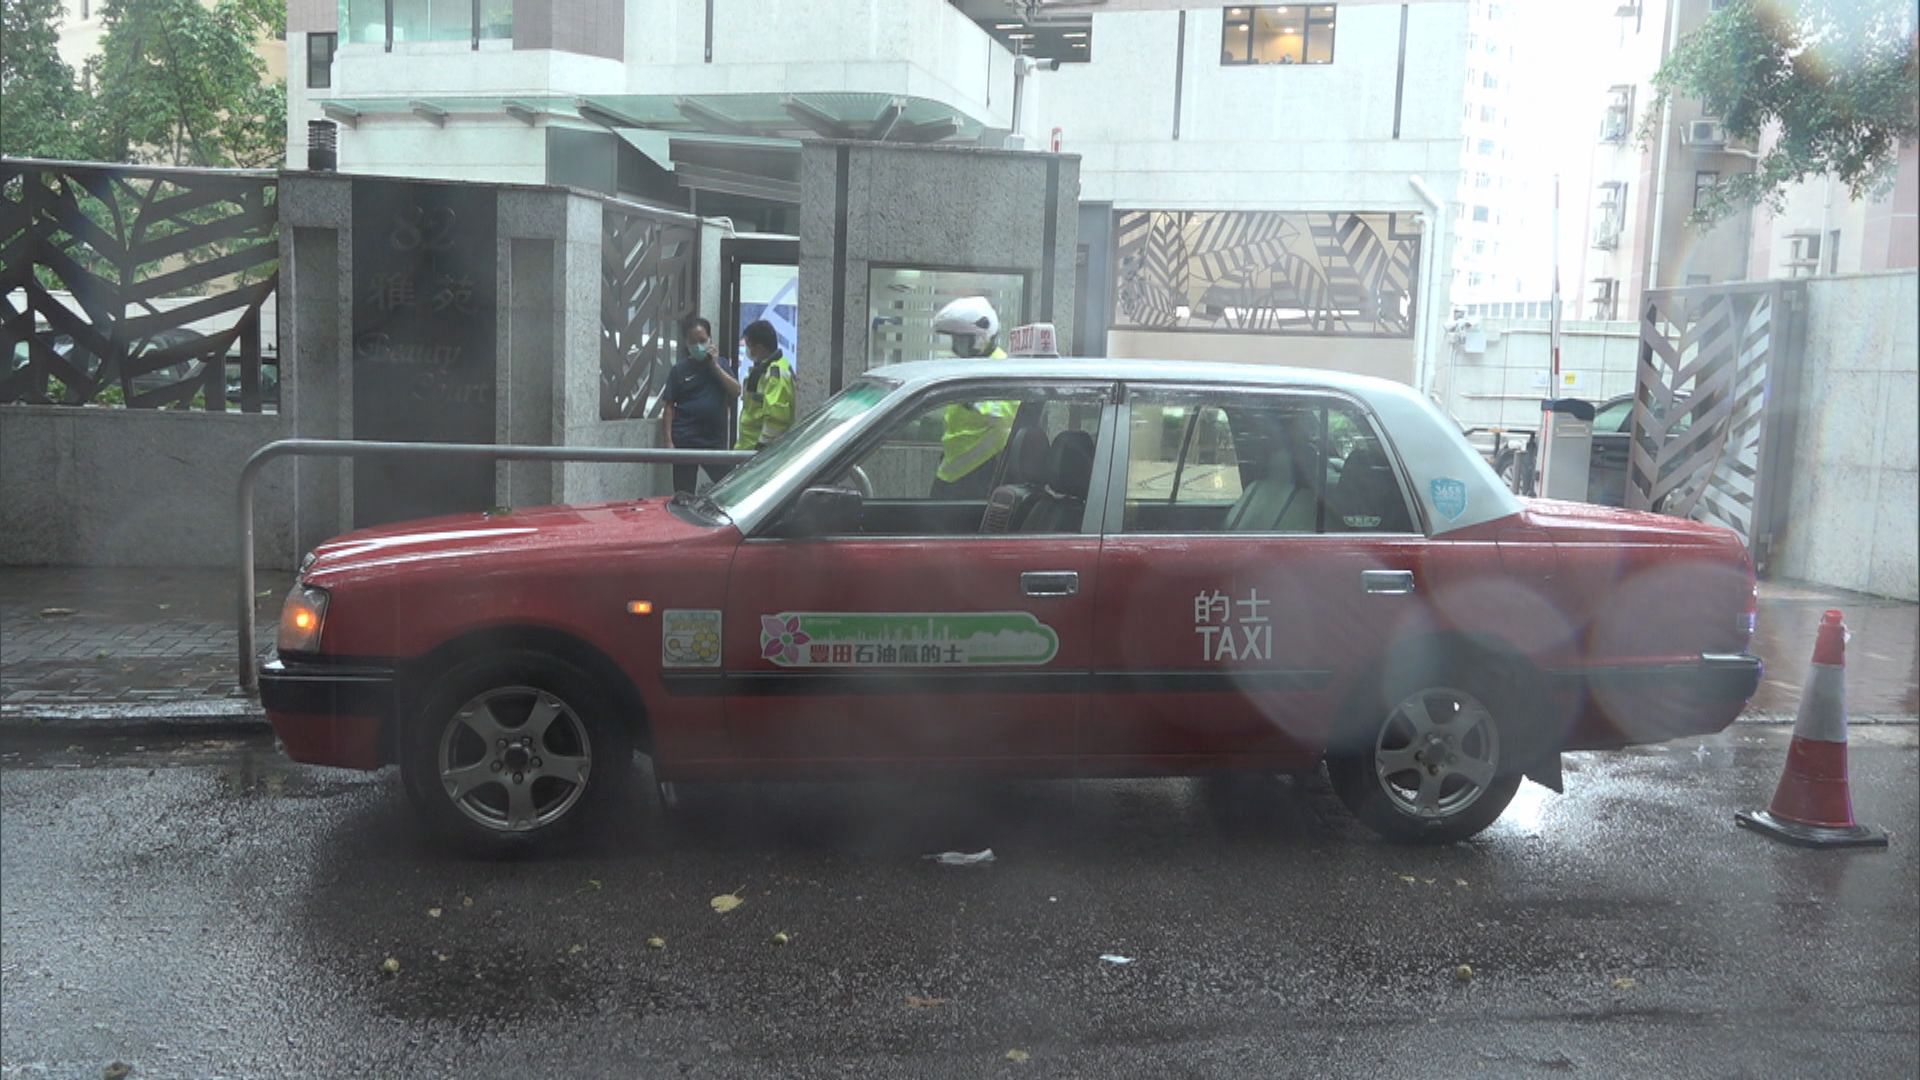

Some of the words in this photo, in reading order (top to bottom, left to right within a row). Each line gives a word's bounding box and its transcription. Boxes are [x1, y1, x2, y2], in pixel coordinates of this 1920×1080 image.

[1194, 588, 1271, 623] 的士
[809, 643, 963, 664] 豐田石油氣的士
[1195, 625, 1272, 661] TAXI
